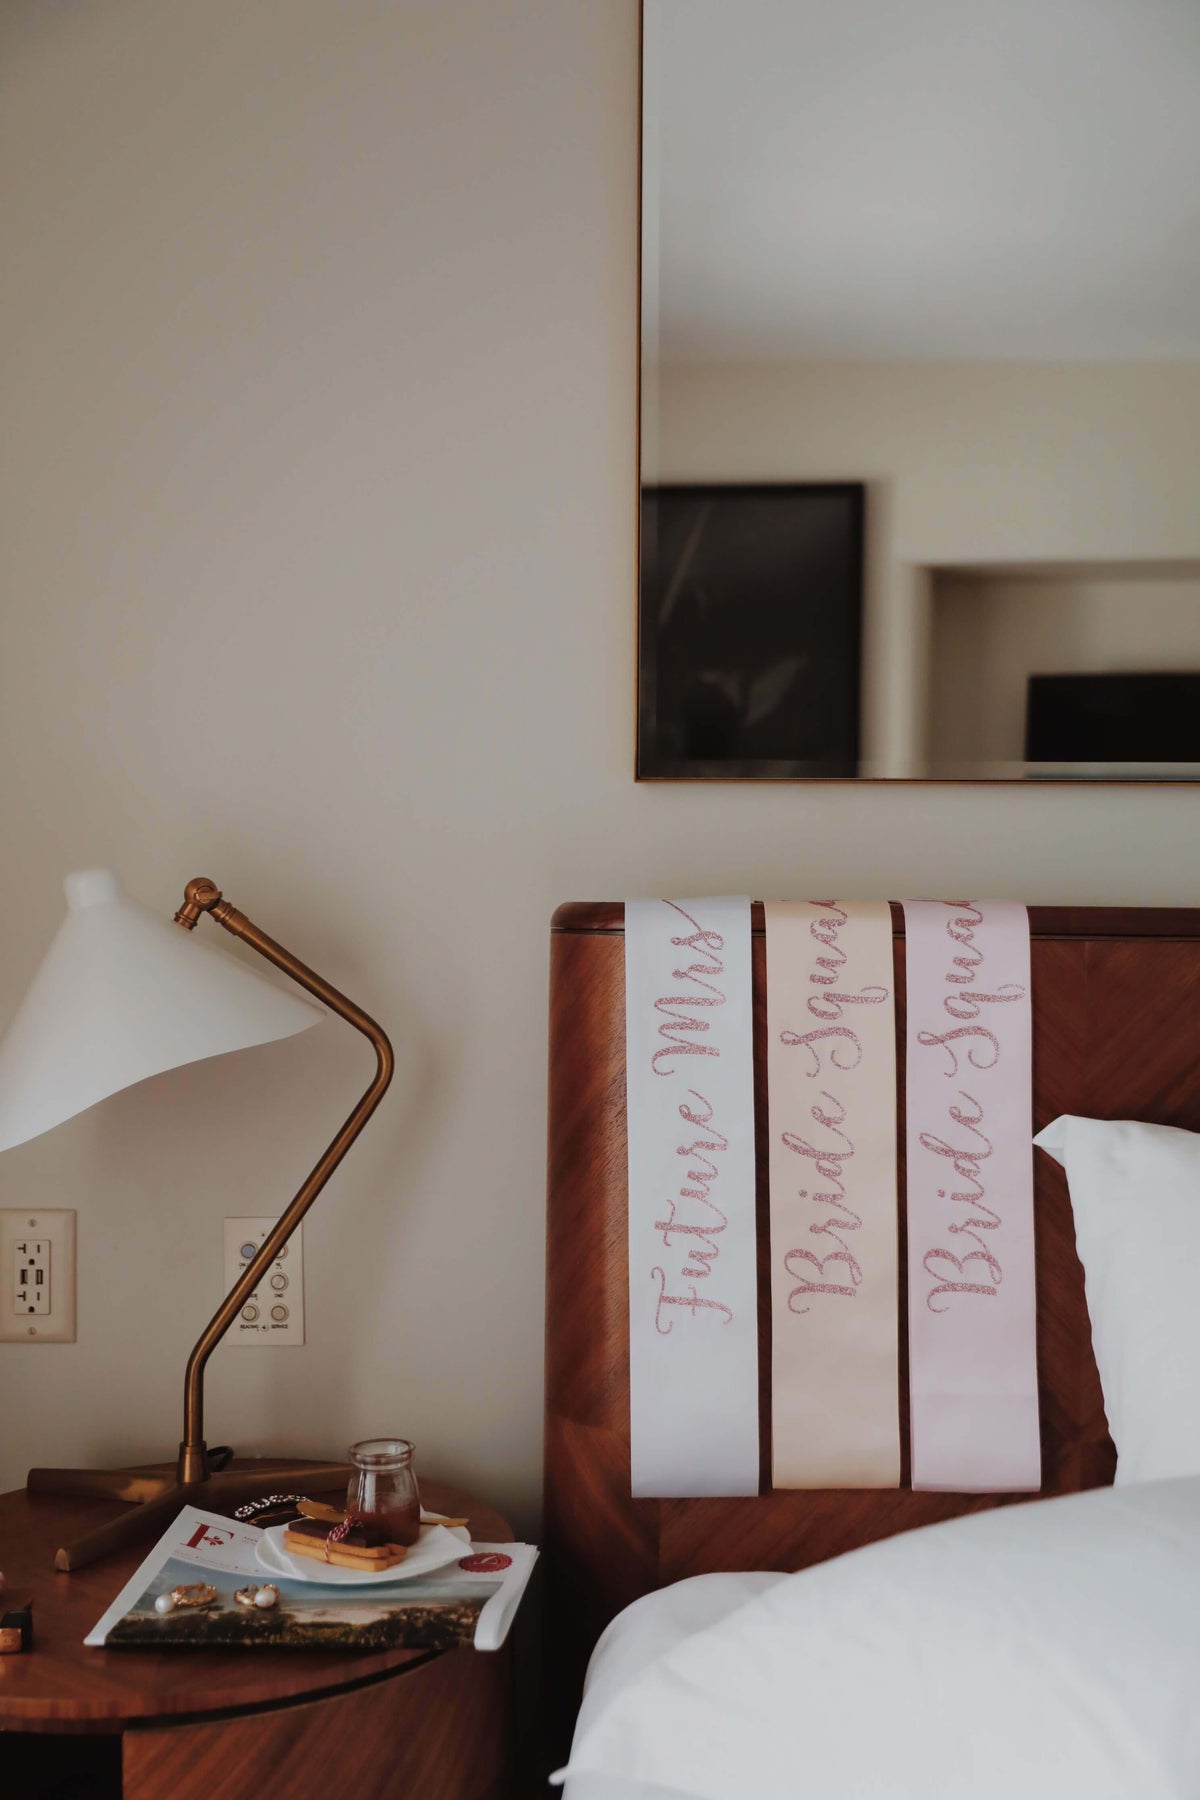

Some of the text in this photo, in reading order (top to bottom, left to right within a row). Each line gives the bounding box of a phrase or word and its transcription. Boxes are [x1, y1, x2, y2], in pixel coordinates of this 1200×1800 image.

[650, 899, 733, 1336] Future Mrs
[780, 1091, 863, 1314] Bride
[918, 1091, 1003, 1313] Bride
